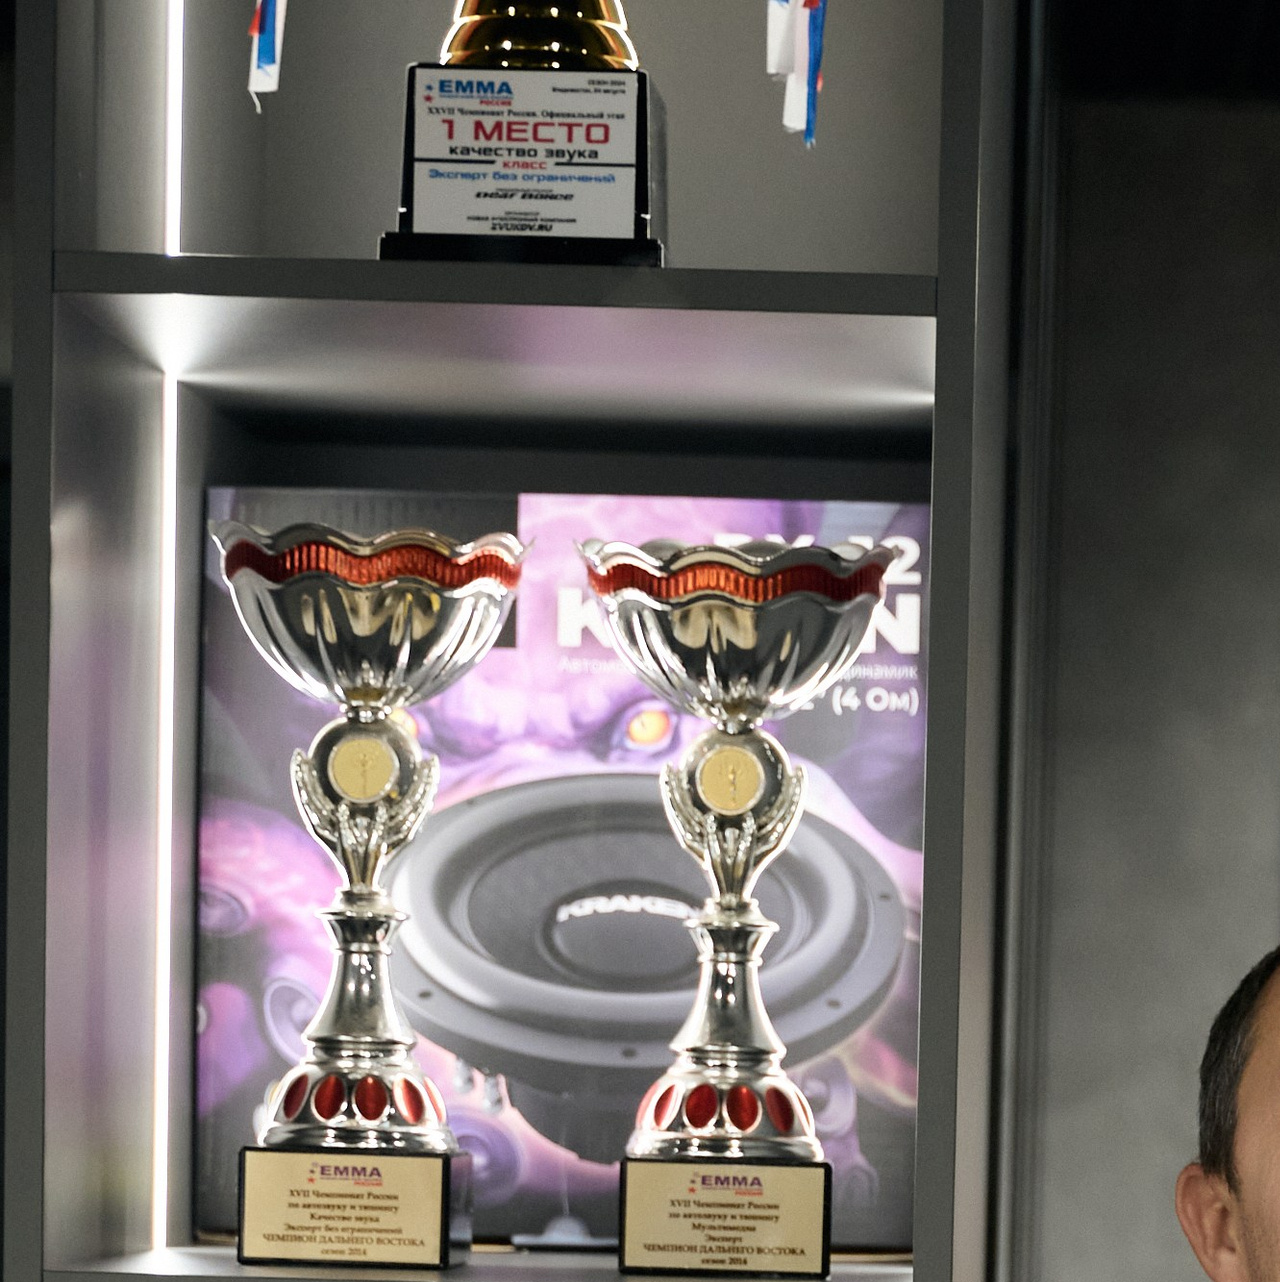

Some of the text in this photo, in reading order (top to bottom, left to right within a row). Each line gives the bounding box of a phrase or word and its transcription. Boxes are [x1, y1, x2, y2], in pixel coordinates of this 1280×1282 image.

[438, 79, 513, 95] EMMA
[441, 119, 610, 144] 1 МЕСТО
[449, 146, 599, 162] качество звука
[429, 169, 488, 181] Эксперт
[492, 171, 518, 182] без
[320, 1165, 382, 1178] EMMA
[701, 1175, 763, 1187] EMMA
[263, 1233, 425, 1247] ЧЕМПИОН ДАЛЬНЕГО ВОСТОКА
[644, 1243, 806, 1256] ЧЕМПИОН ДАЛЬНЕГО ВОСТОКА
